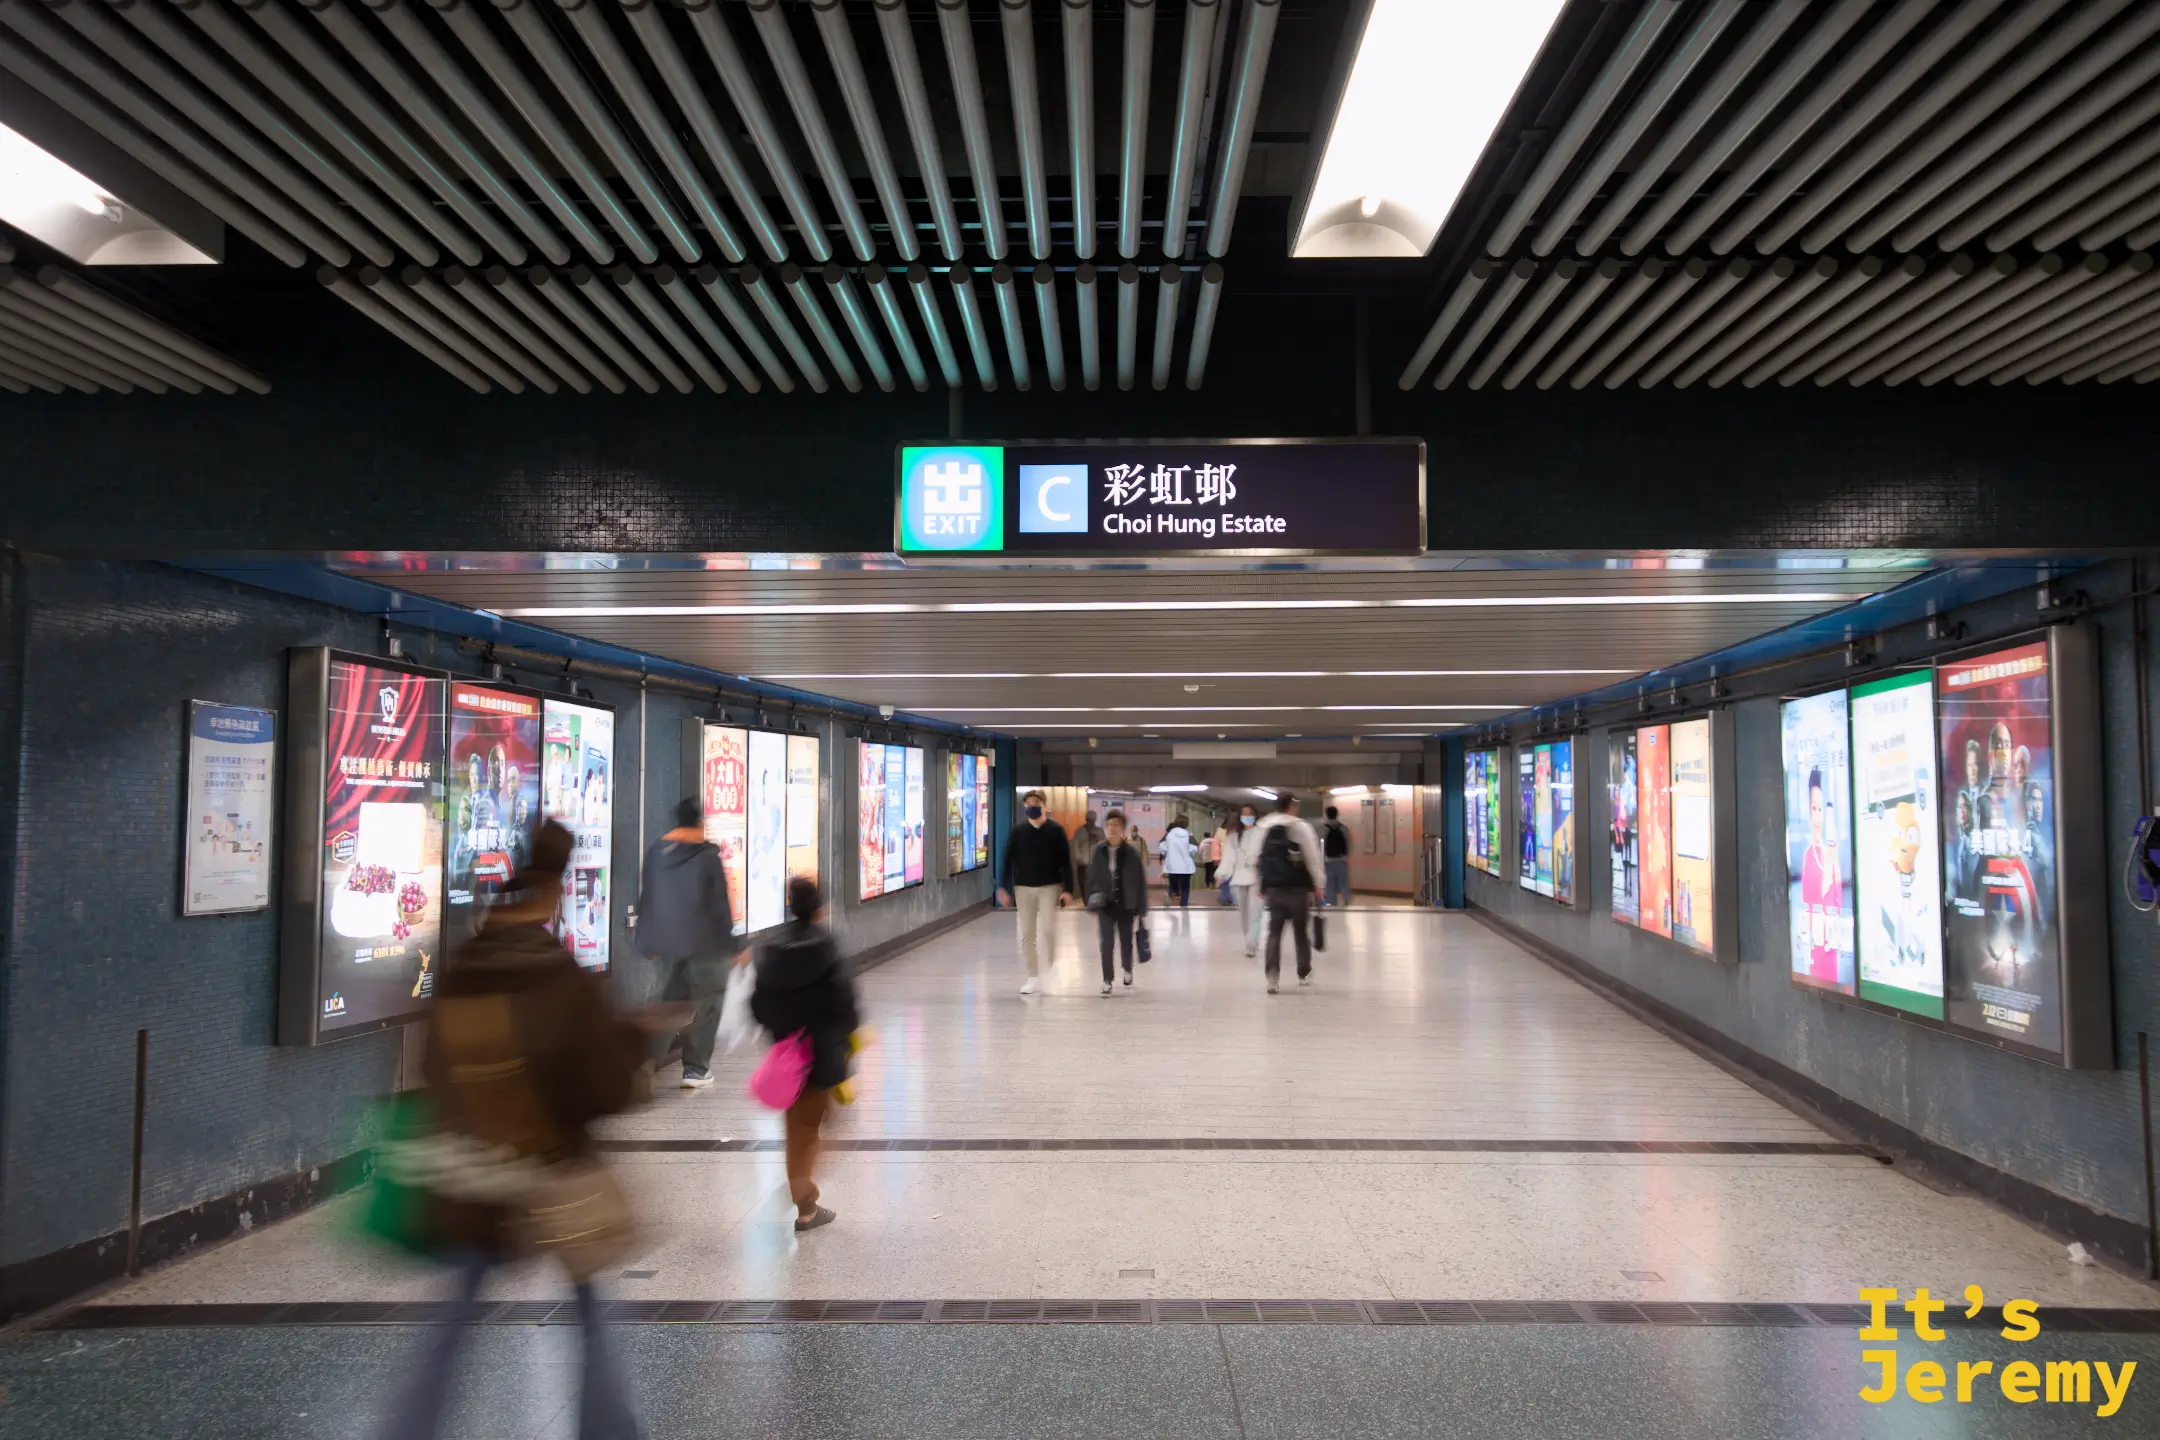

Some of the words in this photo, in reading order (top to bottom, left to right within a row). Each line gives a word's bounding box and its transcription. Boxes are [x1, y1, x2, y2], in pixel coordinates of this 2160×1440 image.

[1038, 477, 1072, 521] C
[1103, 463, 1237, 506] 彩虹邨
[924, 516, 980, 534] EXIT
[1103, 514, 1152, 534] Choi
[1158, 515, 1215, 538] Hung
[1222, 514, 1287, 534] Estate
